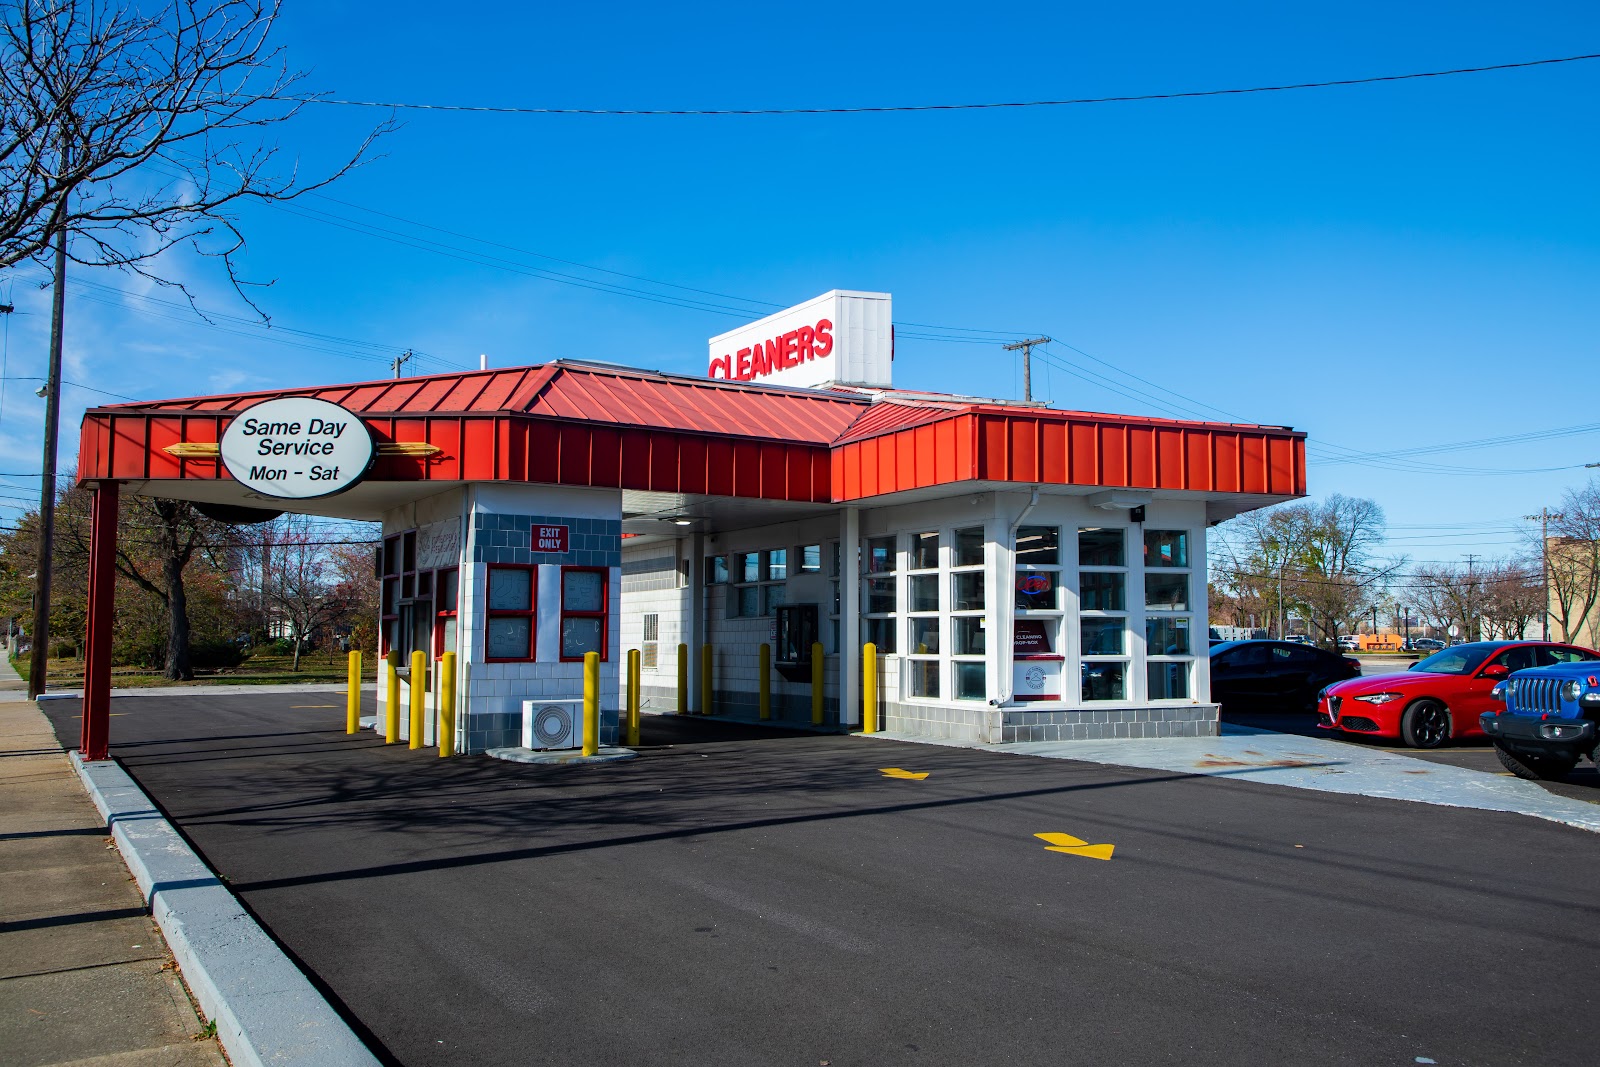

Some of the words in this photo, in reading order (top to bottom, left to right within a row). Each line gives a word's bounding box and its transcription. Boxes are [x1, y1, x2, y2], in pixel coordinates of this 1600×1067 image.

[708, 318, 833, 382] CLEANERS
[242, 418, 301, 436] Same
[308, 418, 347, 439] Day
[257, 438, 335, 456] Service
[249, 465, 288, 481] Mon
[309, 465, 340, 481] Sat
[540, 527, 560, 538] EXIT
[538, 538, 561, 549] ONLY
